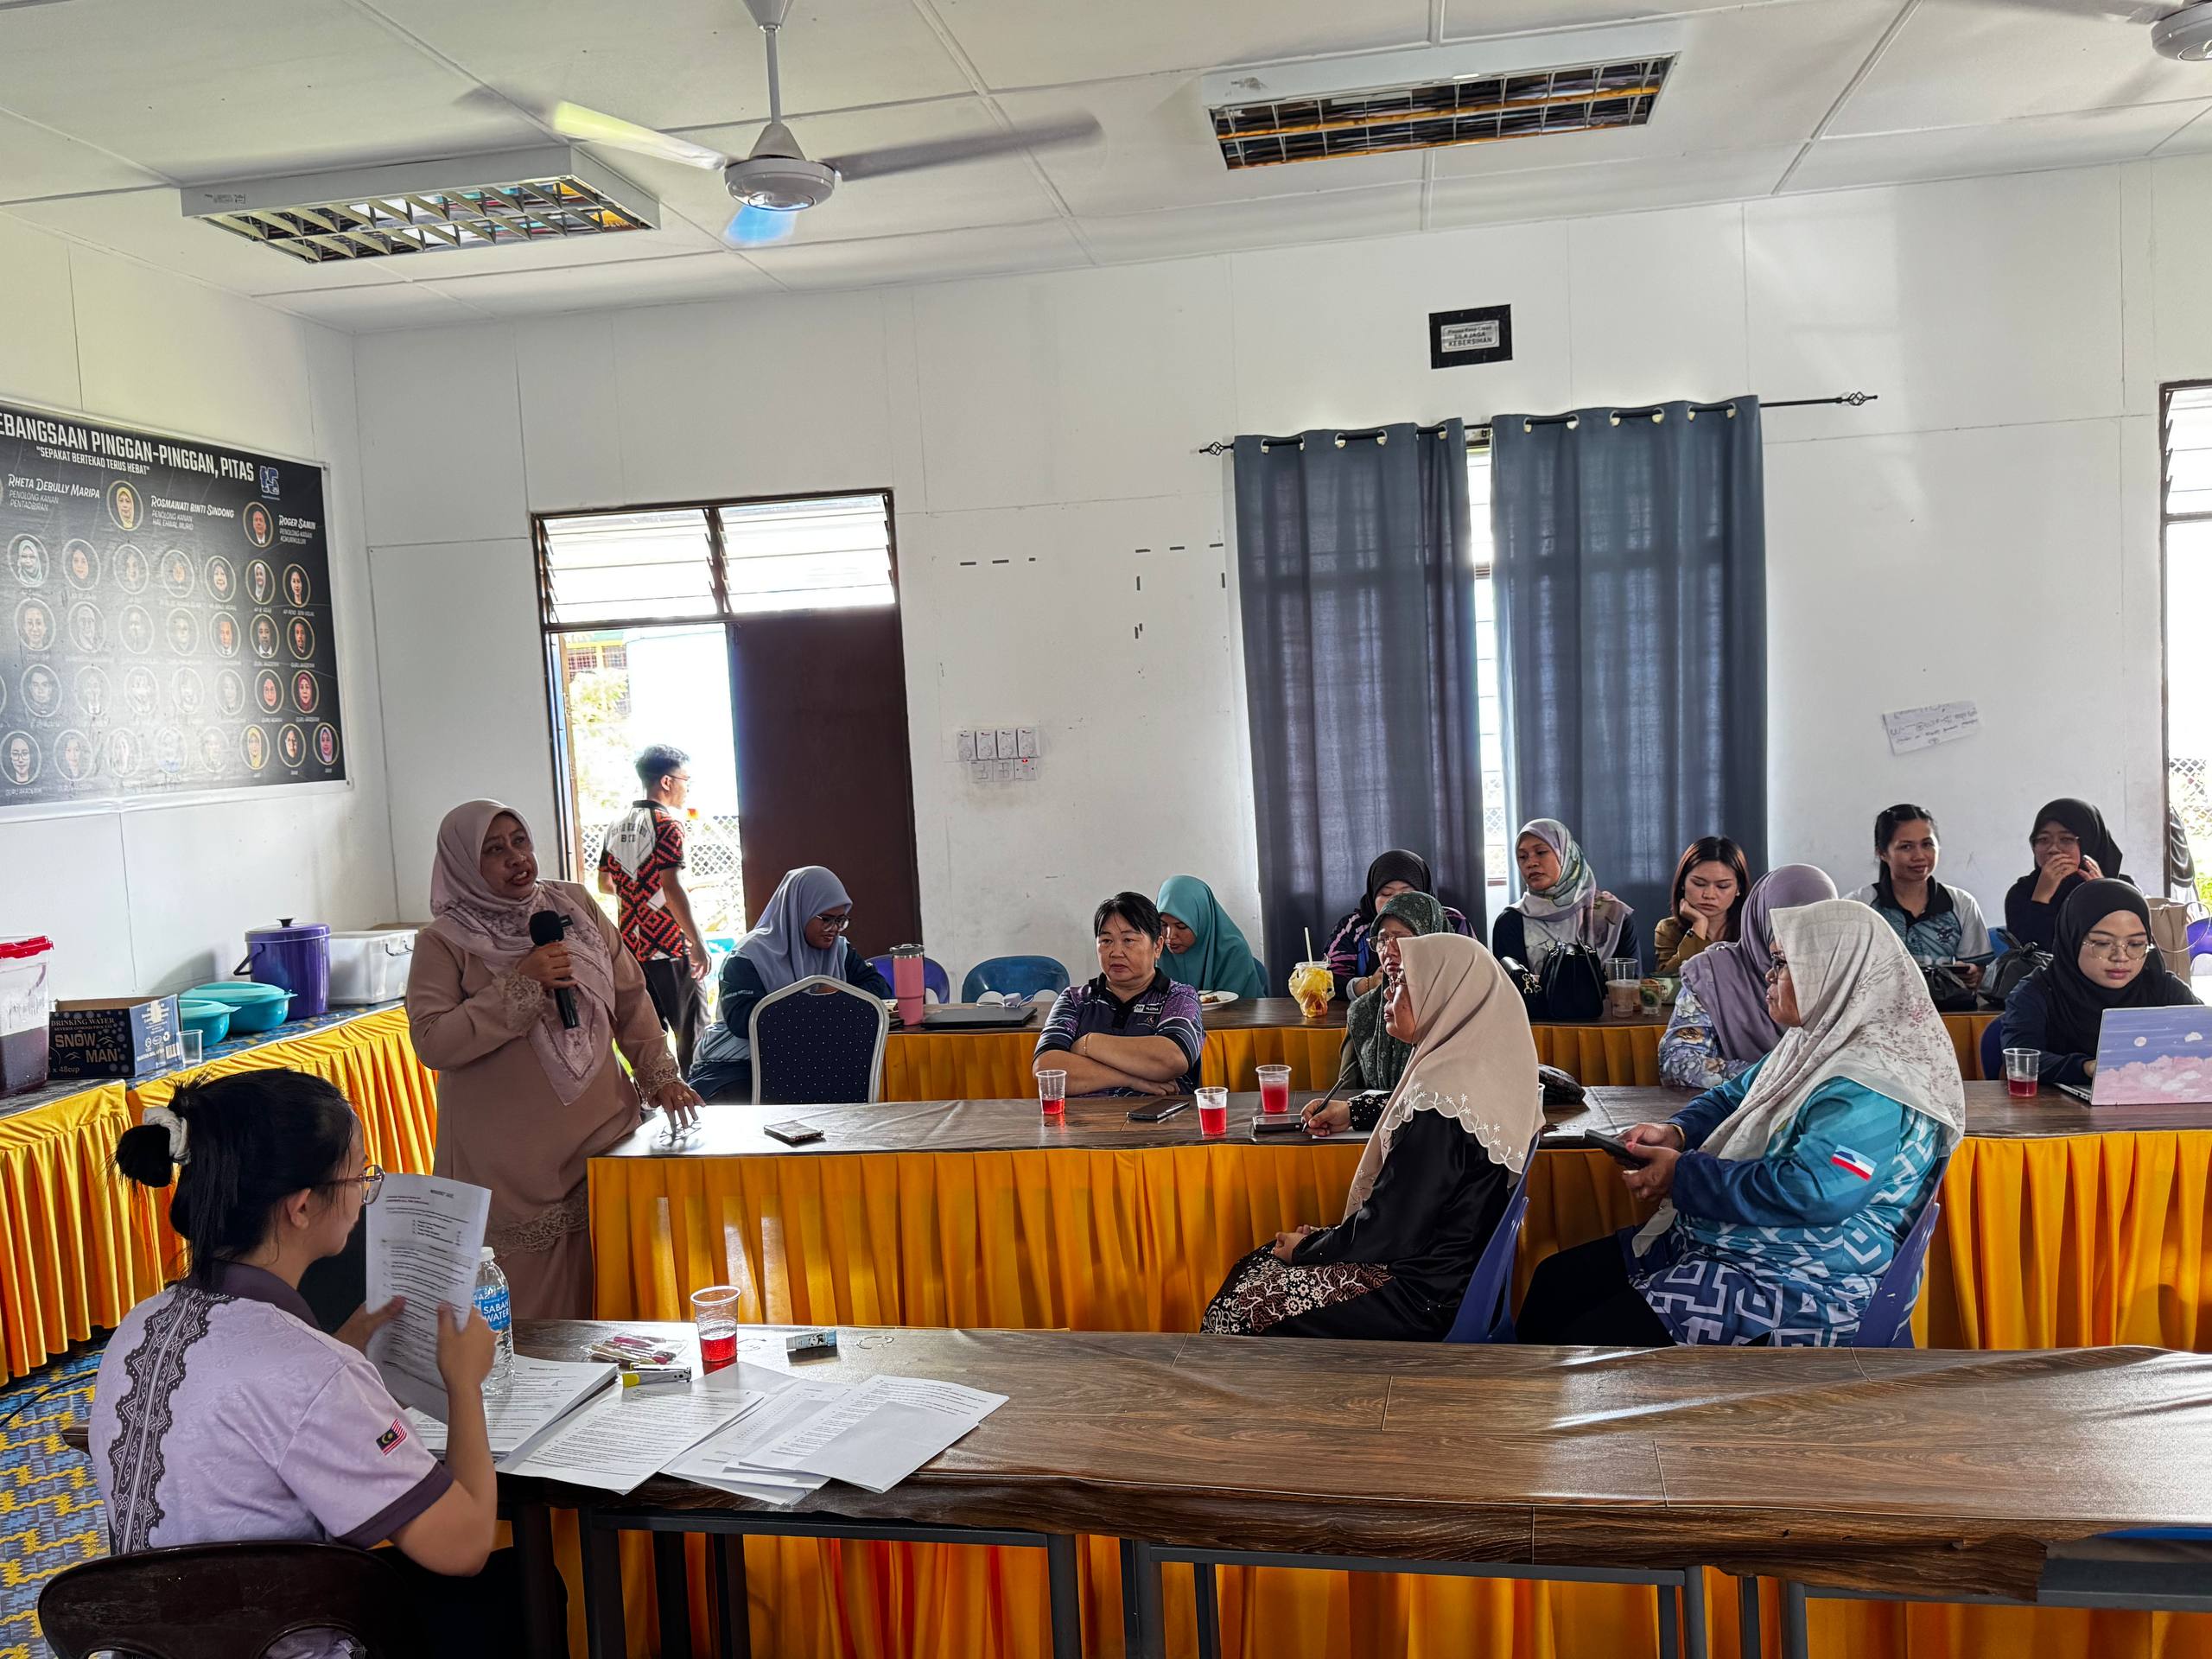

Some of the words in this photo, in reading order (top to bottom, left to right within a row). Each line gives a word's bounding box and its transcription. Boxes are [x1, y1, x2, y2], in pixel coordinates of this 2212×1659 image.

[36, 445, 71, 461] "SEPAKAT
[72, 452, 105, 468] BERTEKAD
[106, 458, 127, 473] TERUS
[127, 462, 150, 475] HEBAT"
[91, 430, 219, 479] PINGGAN-PINGGAN,
[220, 456, 254, 481] PITAS
[8, 474, 34, 489] RHETA
[35, 478, 70, 493] DEBULLY
[70, 484, 100, 499] MARIPA
[150, 495, 189, 512] ROSMAWATI
[207, 504, 235, 518] SINDONG
[278, 514, 298, 527] ROGER
[54, 1033, 96, 1048] SNOW
[86, 1048, 118, 1063] MAN
[483, 1299, 509, 1314] SABAH
[484, 1307, 510, 1322] WATER
